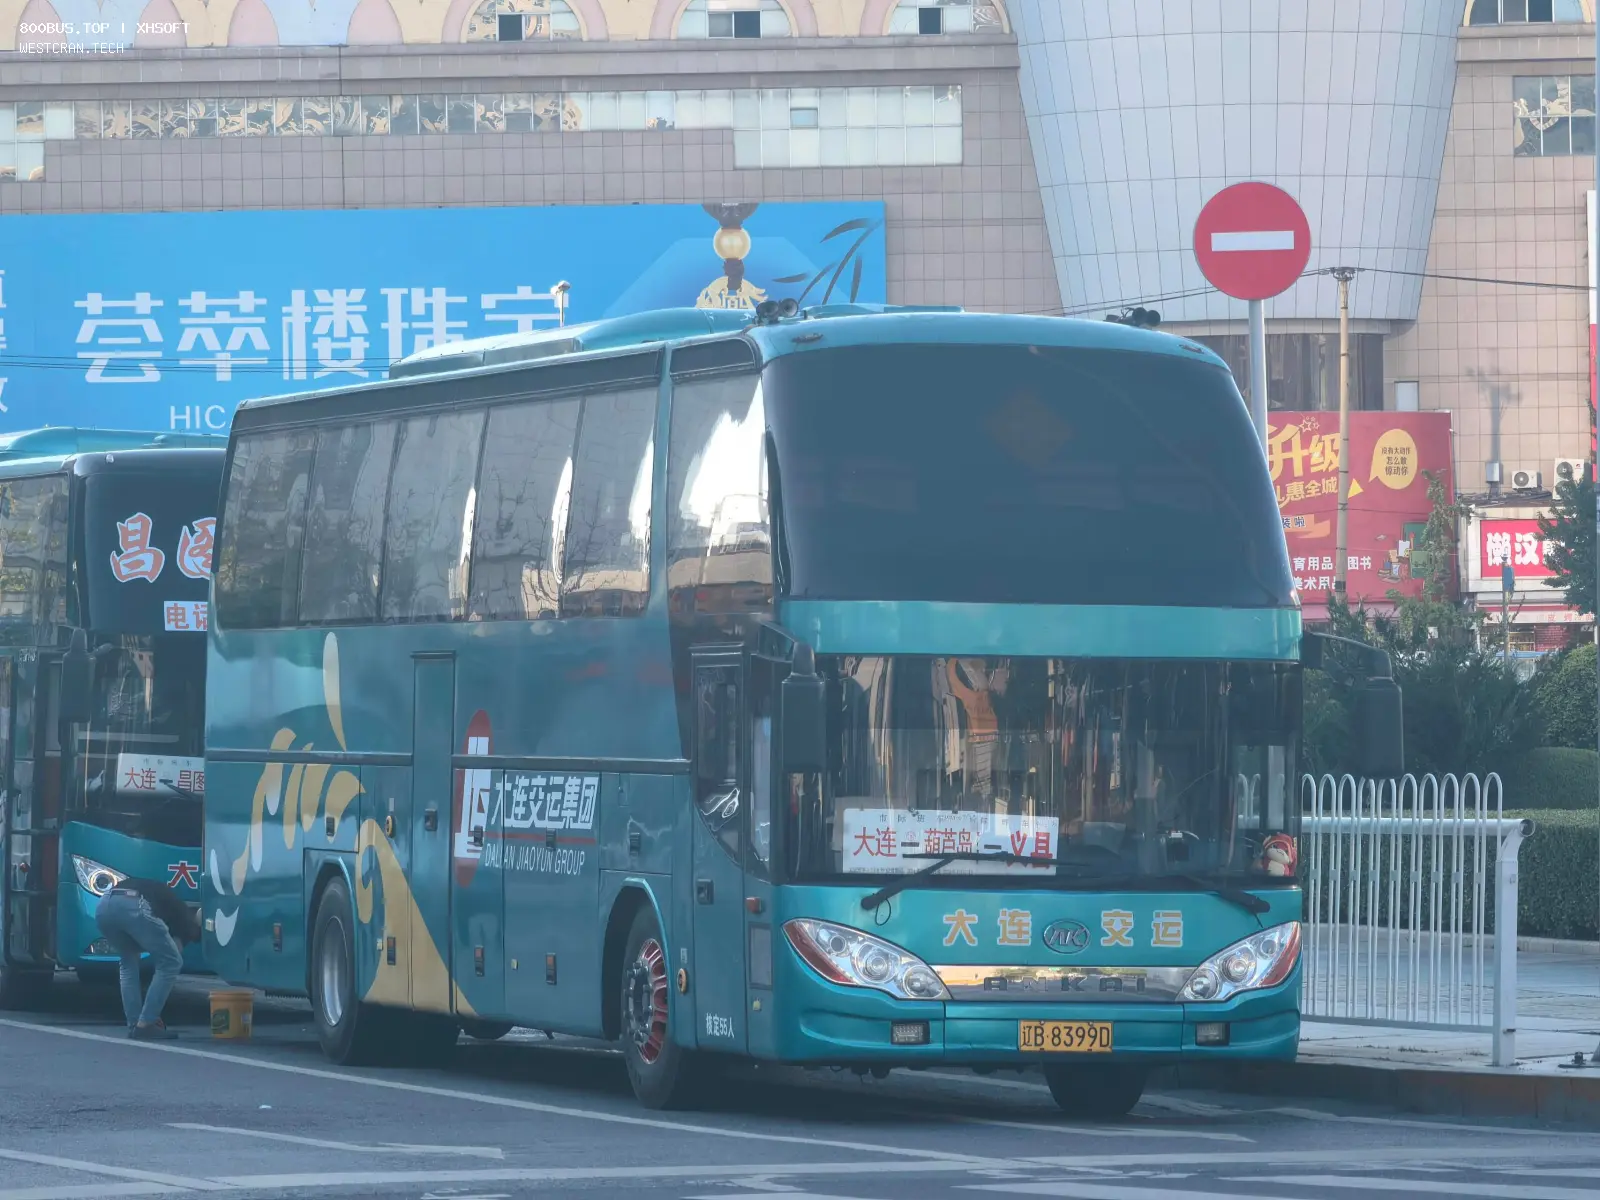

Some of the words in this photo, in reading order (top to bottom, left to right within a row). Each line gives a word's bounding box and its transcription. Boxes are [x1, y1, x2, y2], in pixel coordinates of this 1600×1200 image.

[170, 404, 232, 430] HIC
[1268, 423, 1340, 481] 升级
[124, 767, 157, 790] 大连
[491, 773, 599, 829] 大连交运集团
[853, 826, 898, 858] 大连
[167, 861, 198, 889] 大
[516, 845, 554, 873] JIAOYUN
[554, 848, 586, 876] GROUP
[943, 909, 1032, 946] 大连
[1101, 909, 1184, 947] 交运
[706, 1011, 735, 1038] 核定55人
